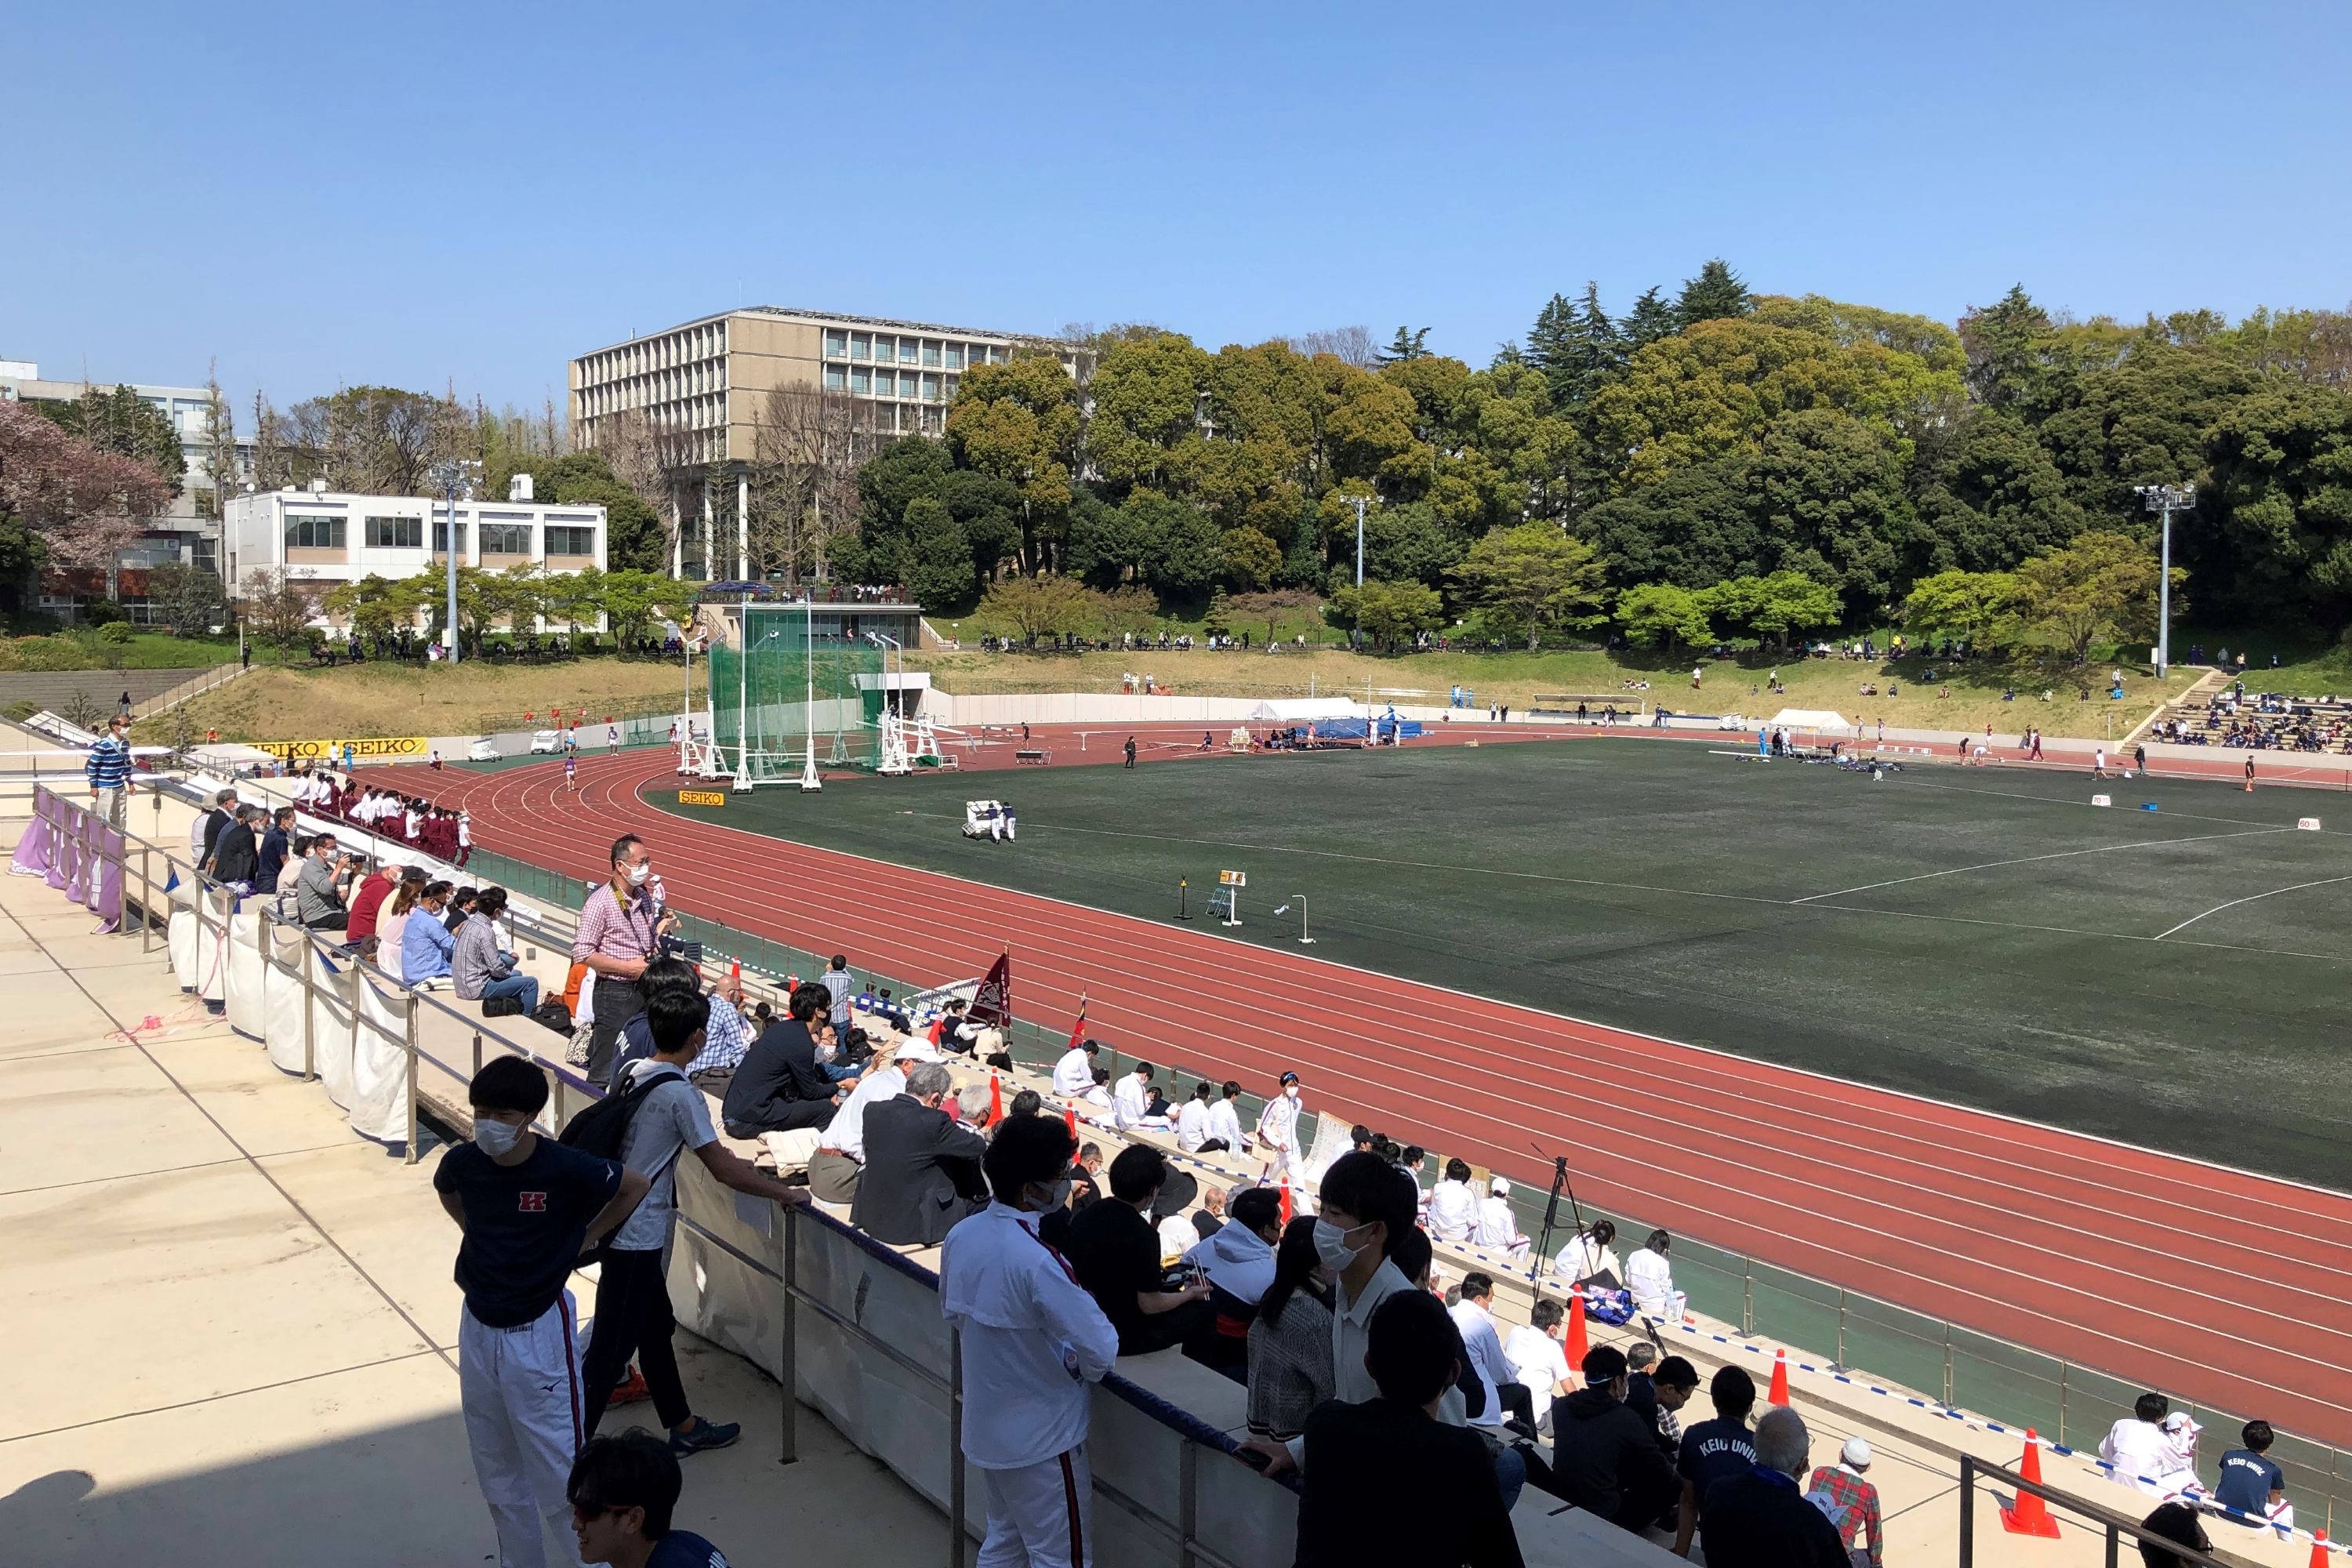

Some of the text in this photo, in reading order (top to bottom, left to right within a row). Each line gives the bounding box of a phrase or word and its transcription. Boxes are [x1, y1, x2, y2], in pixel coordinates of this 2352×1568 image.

[250, 742, 319, 757] EIKO
[343, 739, 416, 755] SEIKO
[681, 792, 720, 804] SEIKO
[1698, 1438, 1729, 1457] KEIO
[2227, 1457, 2246, 1466] KEIO
